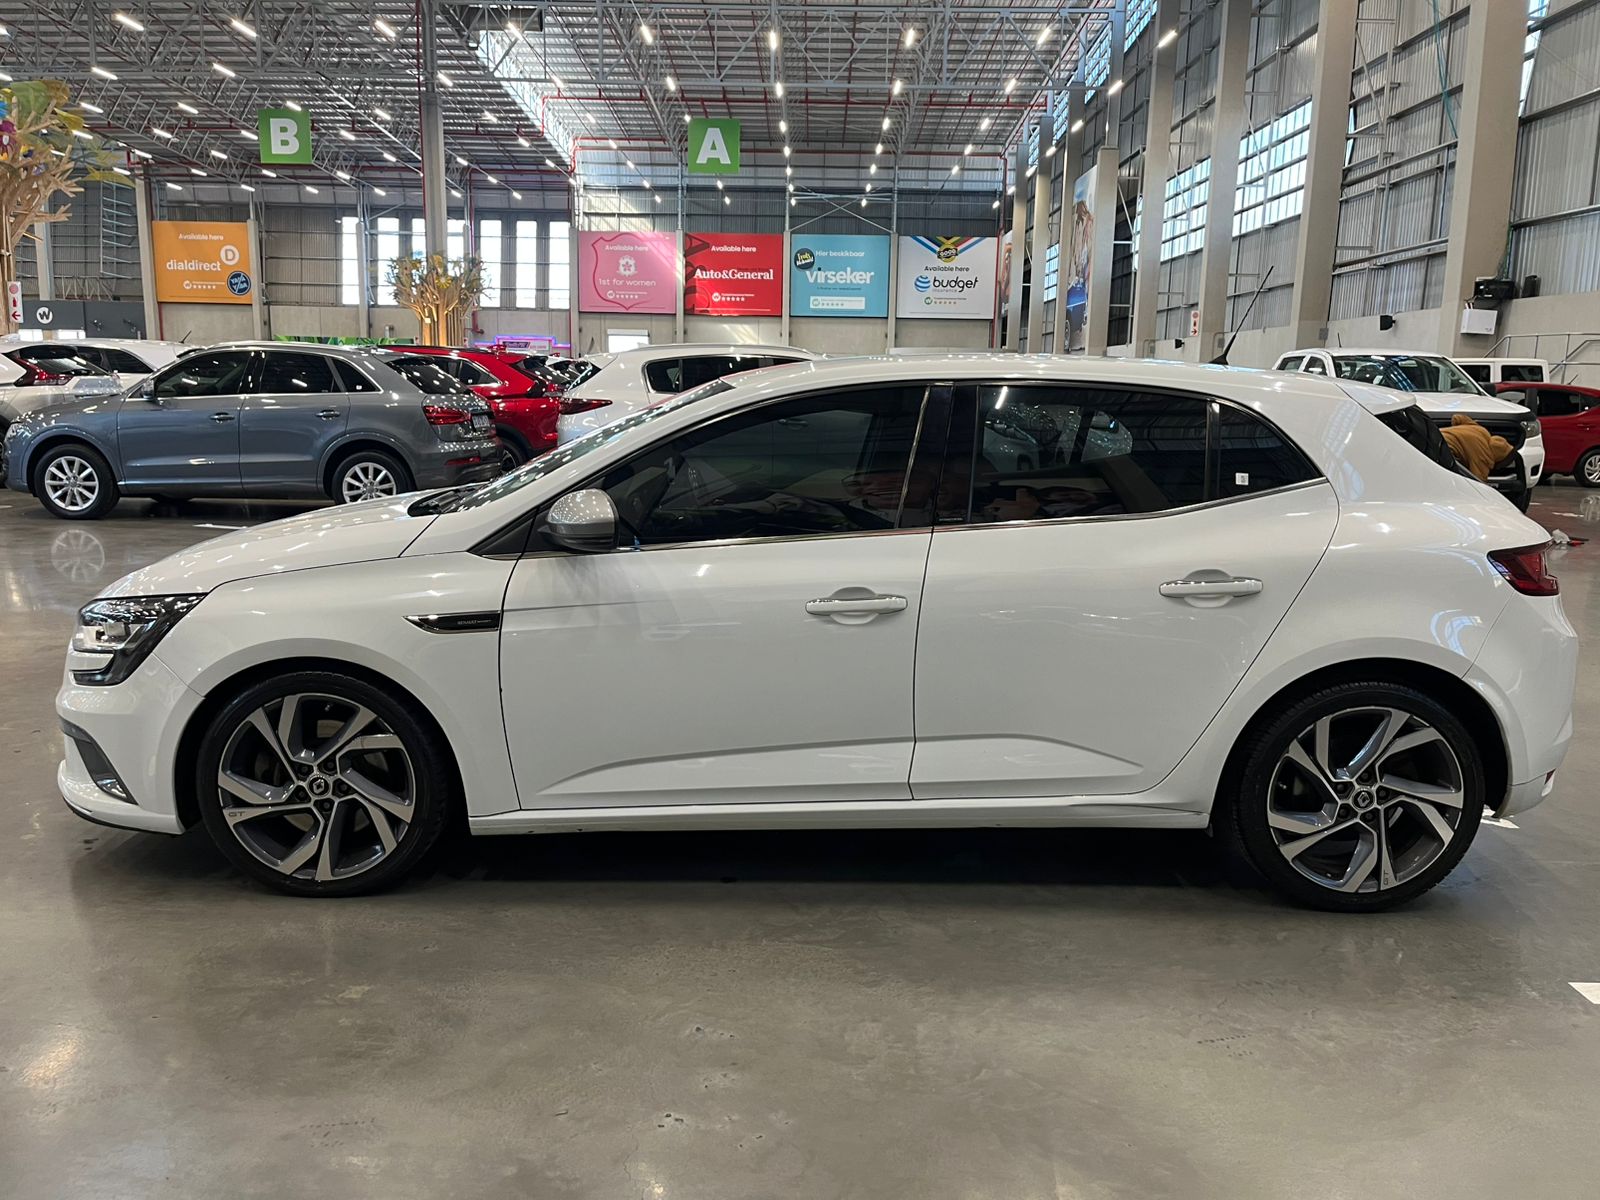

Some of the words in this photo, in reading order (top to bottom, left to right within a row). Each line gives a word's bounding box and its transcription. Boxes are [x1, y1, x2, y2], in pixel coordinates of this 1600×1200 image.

[270, 118, 299, 154] B
[695, 127, 731, 164] A
[166, 259, 221, 271] dialdirect
[694, 268, 774, 280] Auto&General
[805, 267, 875, 284] virseker
[598, 278, 610, 286] 1st
[932, 276, 979, 293] budget
[38, 308, 51, 321] W
